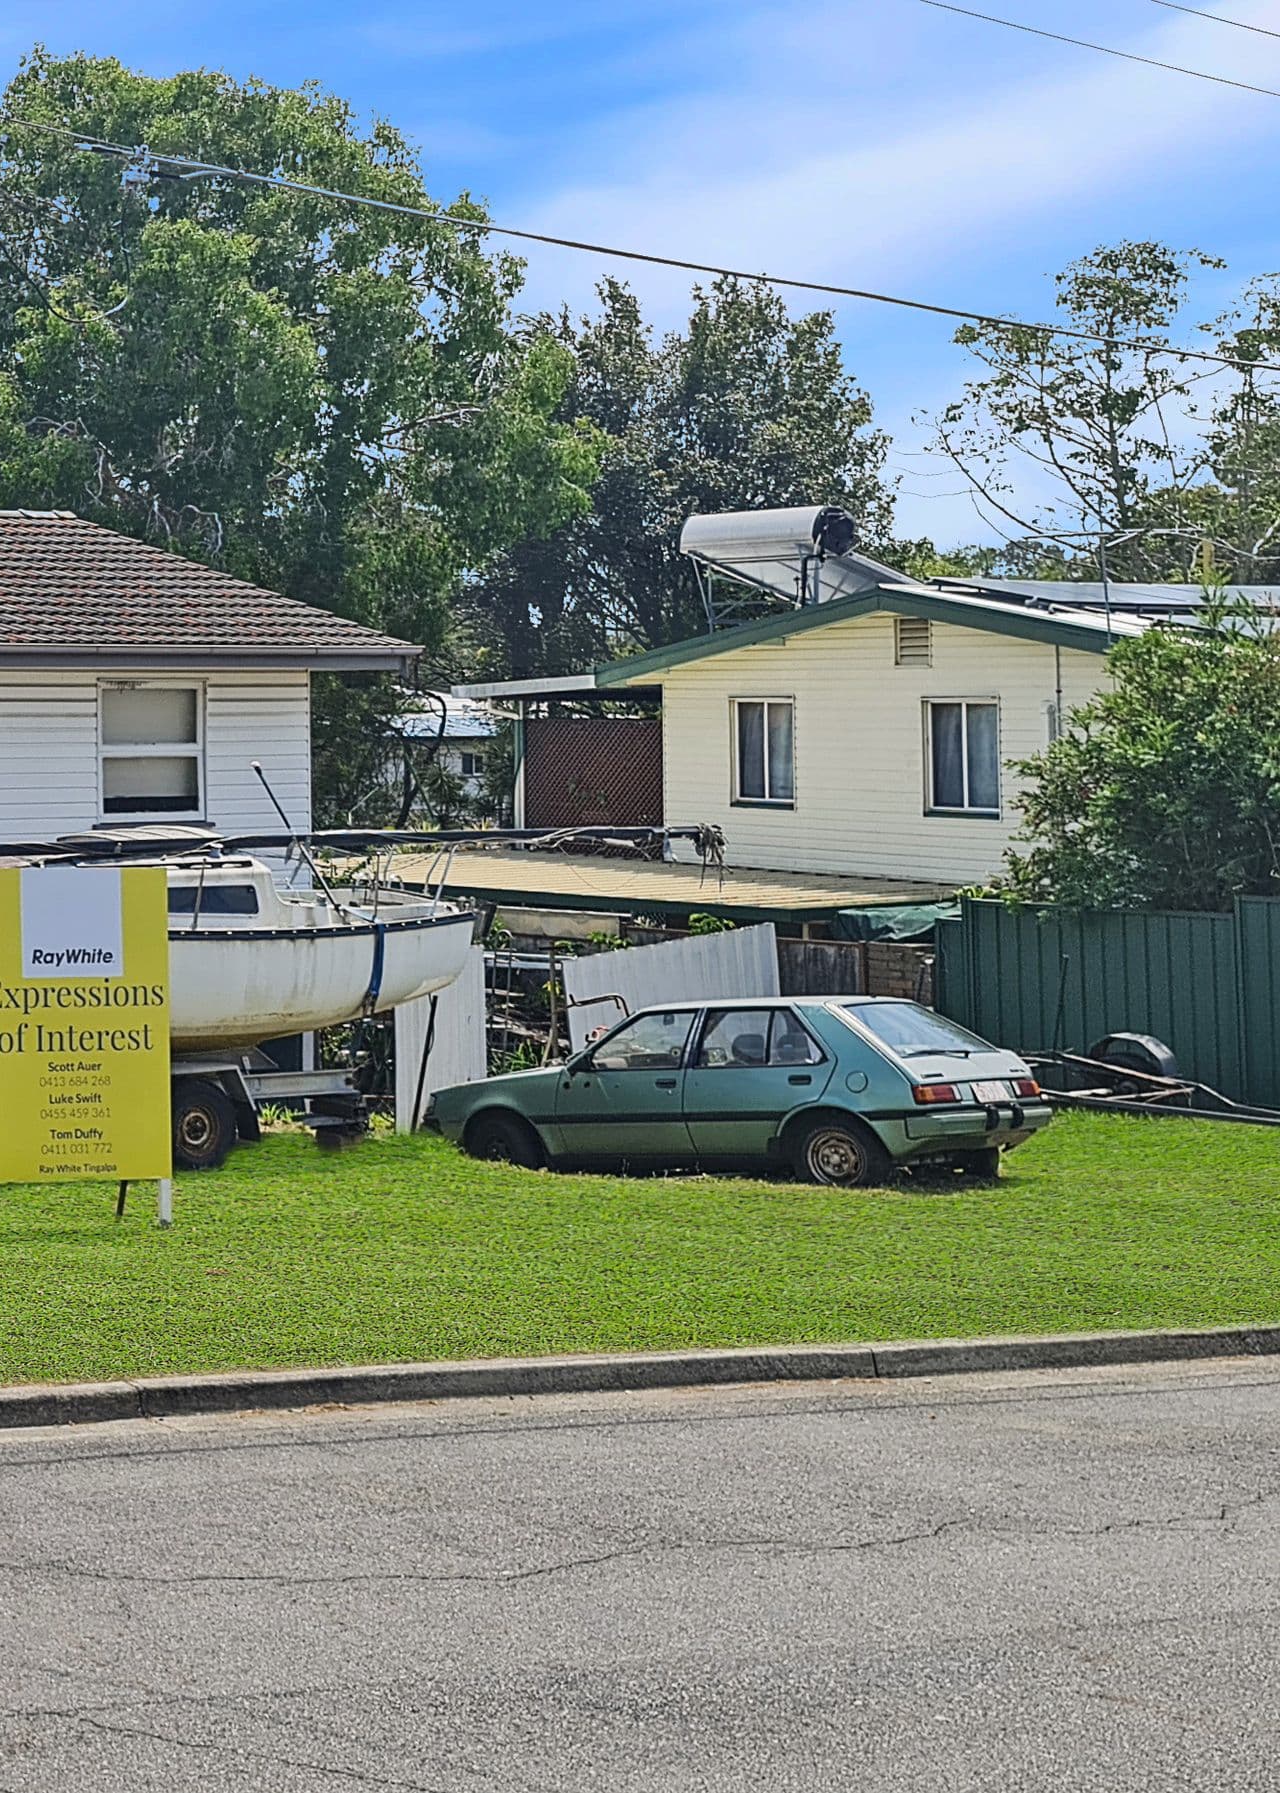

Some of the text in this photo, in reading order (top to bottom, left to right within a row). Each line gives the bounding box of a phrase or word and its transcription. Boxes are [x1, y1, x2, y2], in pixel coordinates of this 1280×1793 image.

[35, 1023, 154, 1053] Interest
[47, 1061, 103, 1073] Scott Auer
[39, 1076, 66, 1088] 0413
[91, 1075, 112, 1087] 268
[49, 1092, 103, 1105] Luke Swift
[39, 1108, 67, 1120] 0455
[91, 1107, 111, 1118] 361
[49, 1128, 104, 1140] Tom Duffy
[40, 1143, 67, 1155] 0411
[92, 1142, 113, 1154] 772
[39, 1162, 118, 1175] Ray White Tingalpa
